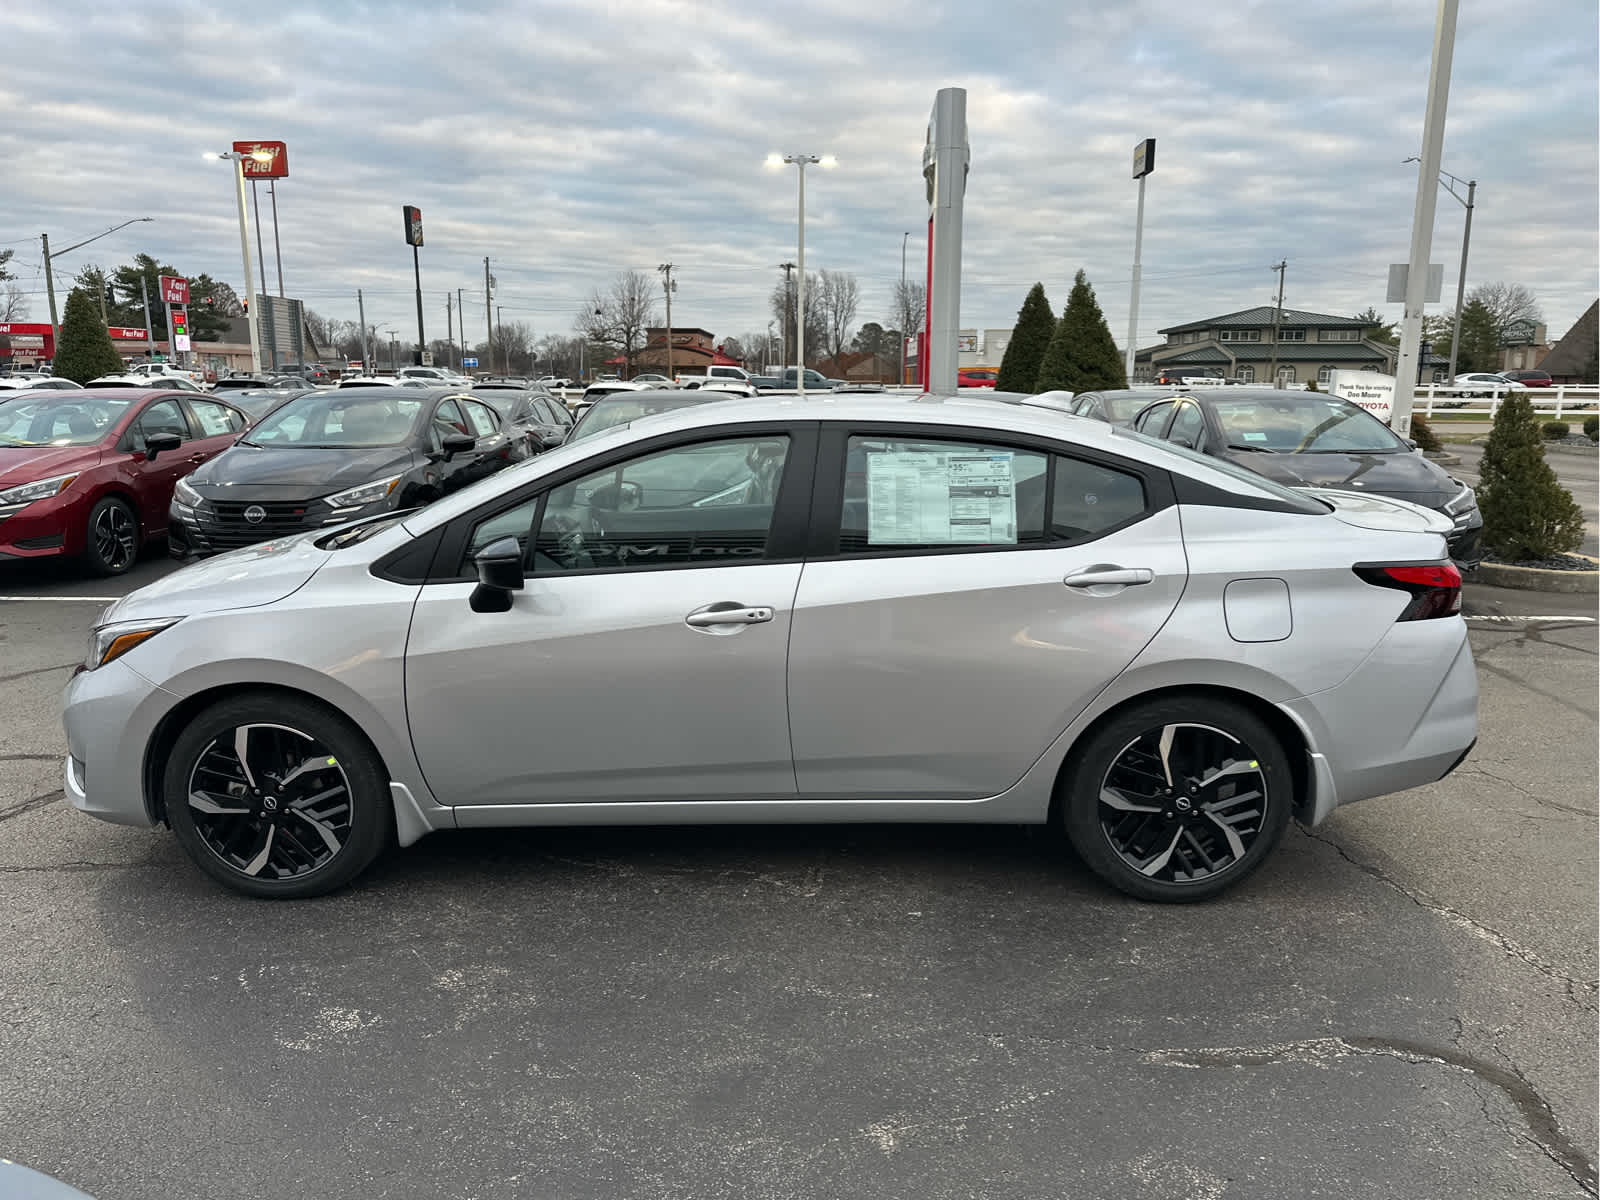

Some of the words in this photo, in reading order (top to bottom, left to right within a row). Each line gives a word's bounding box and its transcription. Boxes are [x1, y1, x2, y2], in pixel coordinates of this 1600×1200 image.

[244, 159, 273, 173] Fuel
[170, 280, 186, 290] Fast
[167, 290, 182, 301] Fuel
